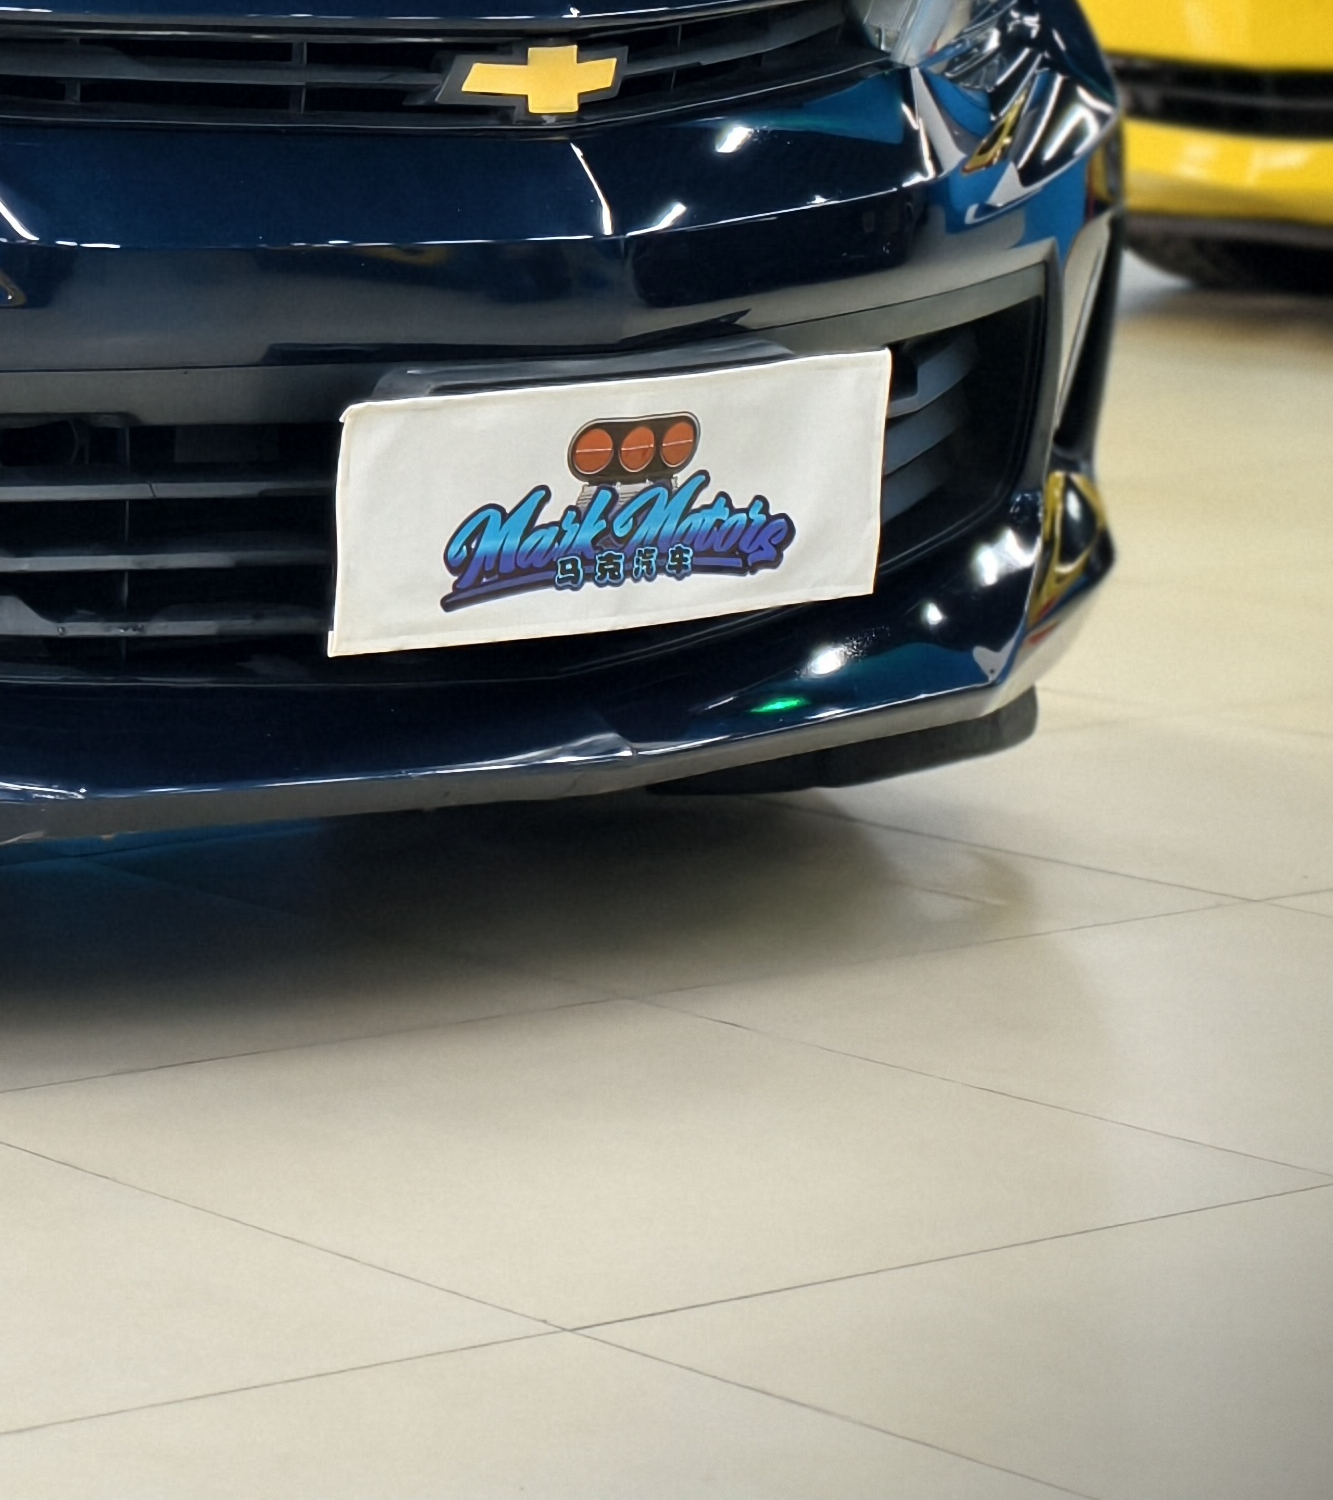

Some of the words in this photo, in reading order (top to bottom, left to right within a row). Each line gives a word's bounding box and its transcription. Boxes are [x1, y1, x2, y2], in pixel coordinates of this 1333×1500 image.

[444, 485, 617, 591] Mark
[613, 470, 796, 575] Motors
[555, 543, 694, 592] 马克汽车
